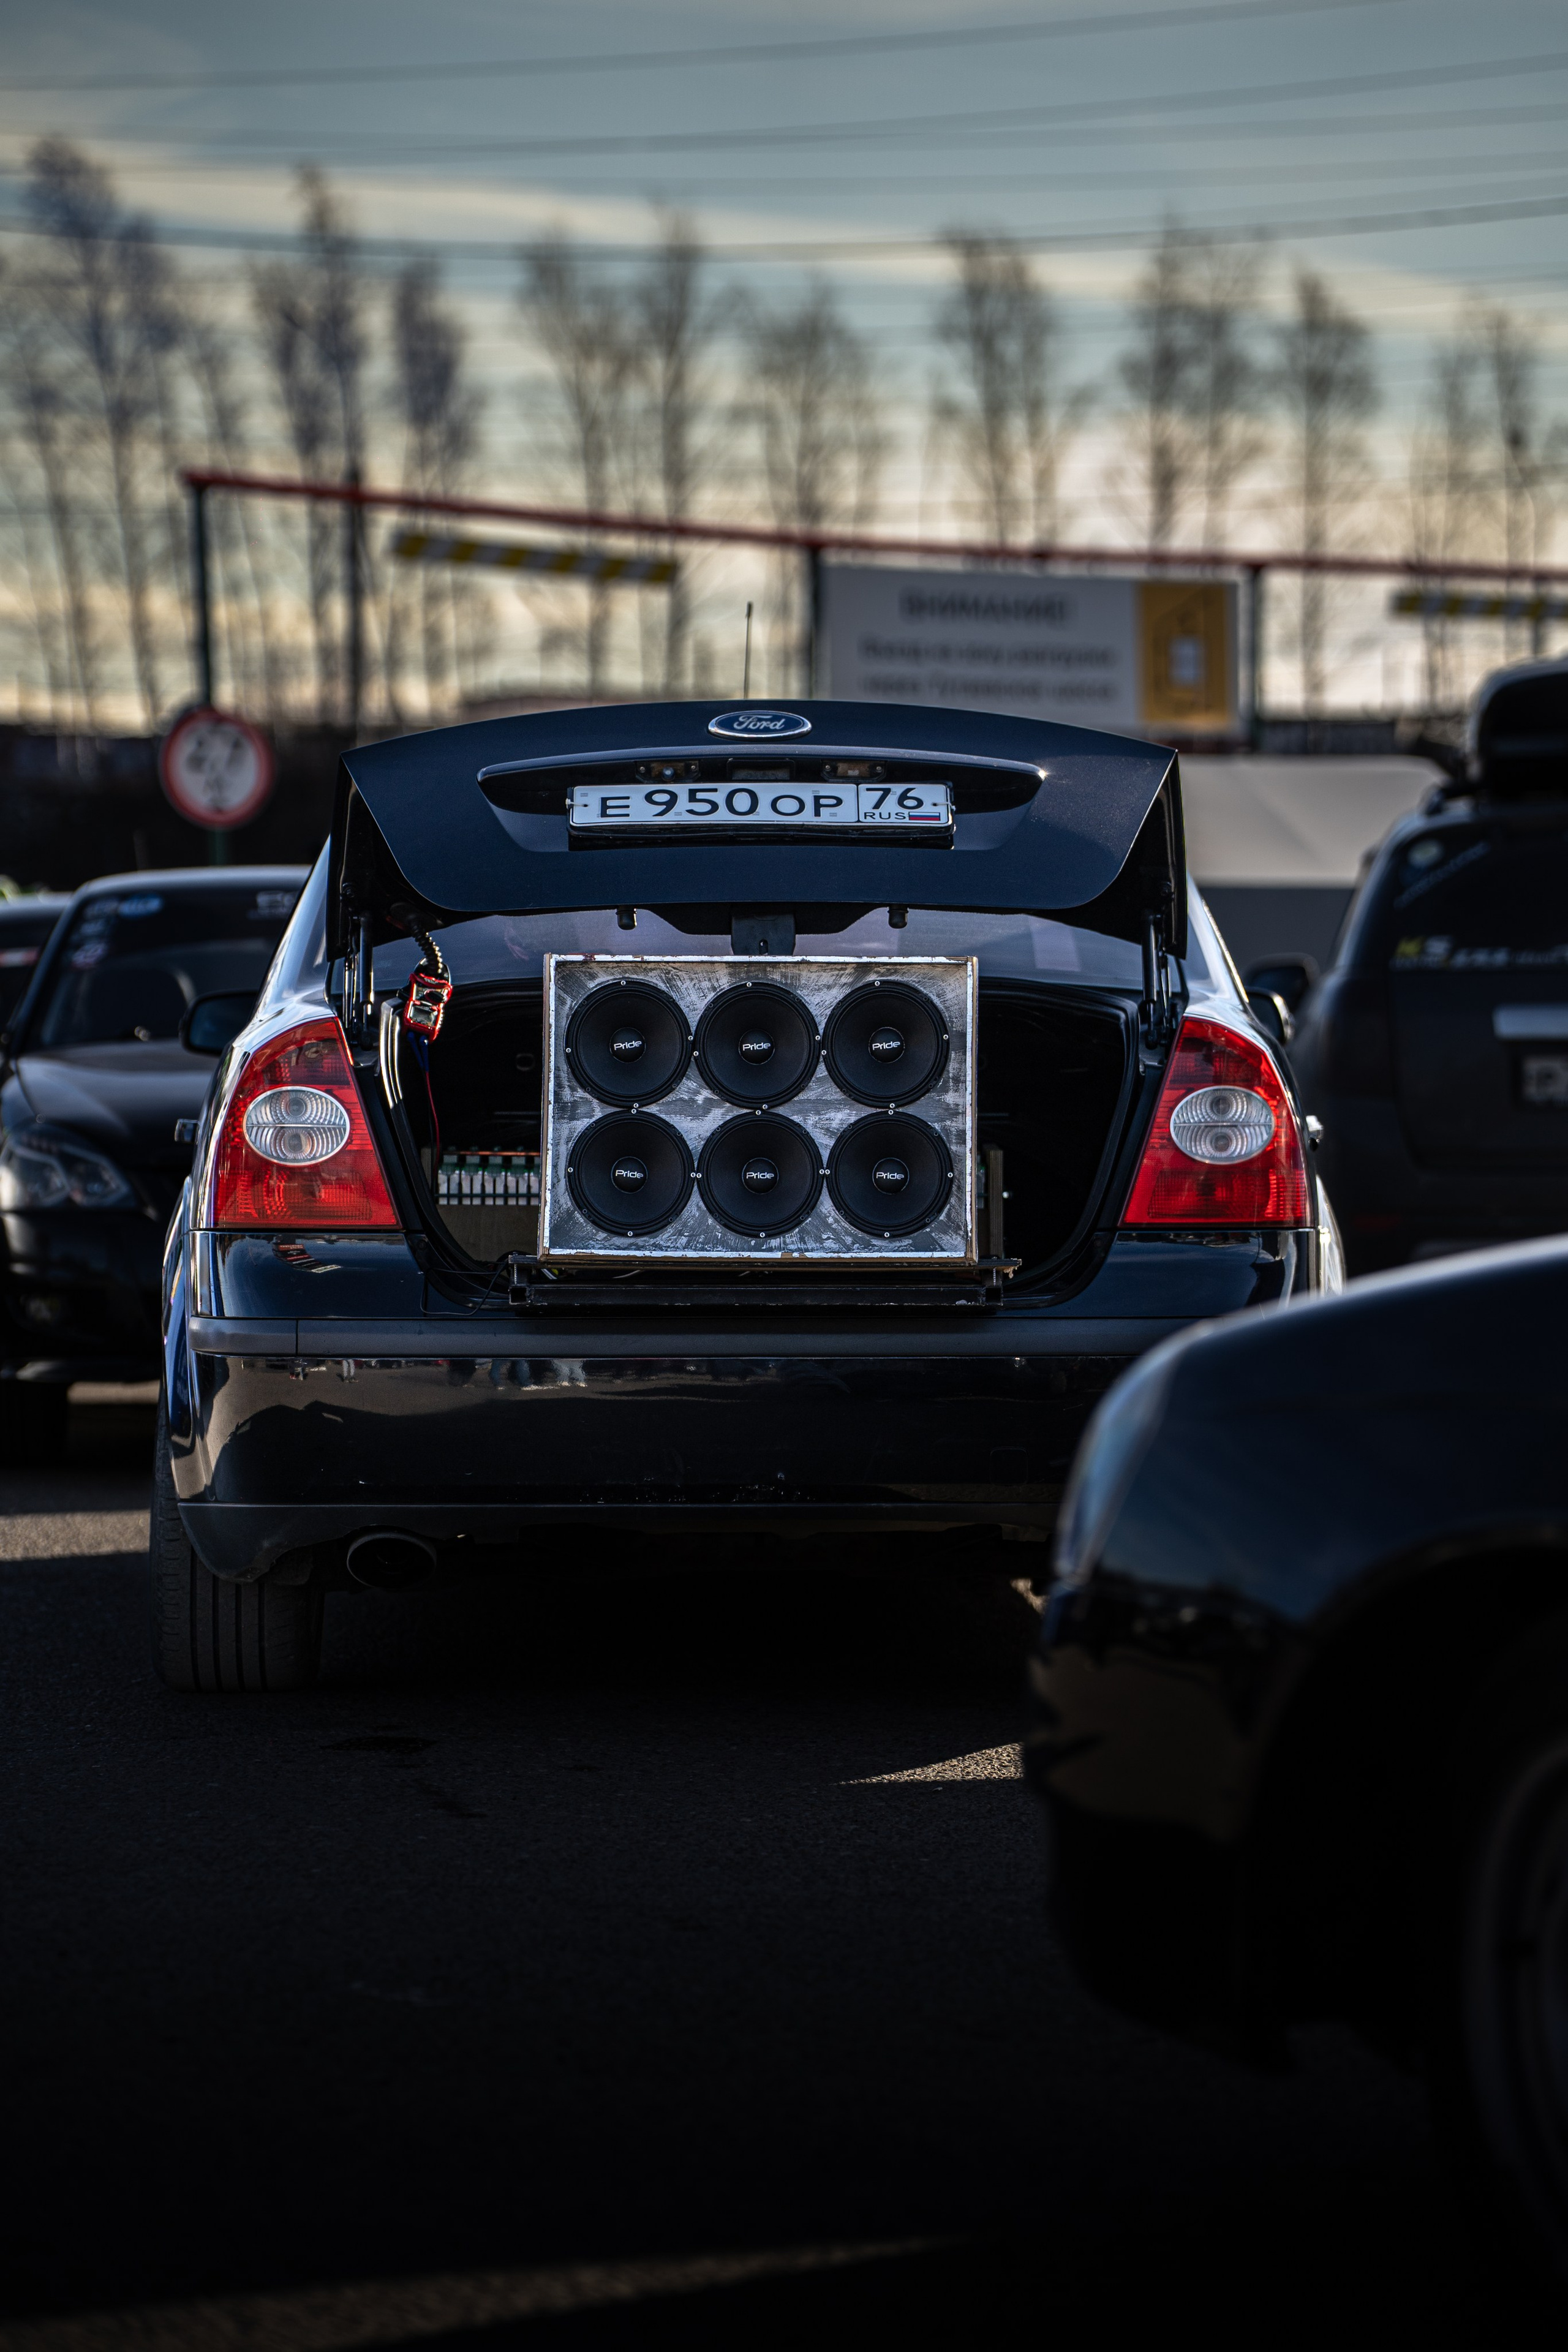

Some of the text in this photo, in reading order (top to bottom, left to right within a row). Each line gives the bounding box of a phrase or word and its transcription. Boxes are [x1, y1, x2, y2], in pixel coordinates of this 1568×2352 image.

[733, 715, 785, 729] Ford
[865, 788, 924, 810] 76
[614, 1041, 642, 1050] Pride
[742, 1042, 771, 1051] Pride
[872, 1041, 900, 1050] Pride
[615, 1170, 643, 1178] Pride
